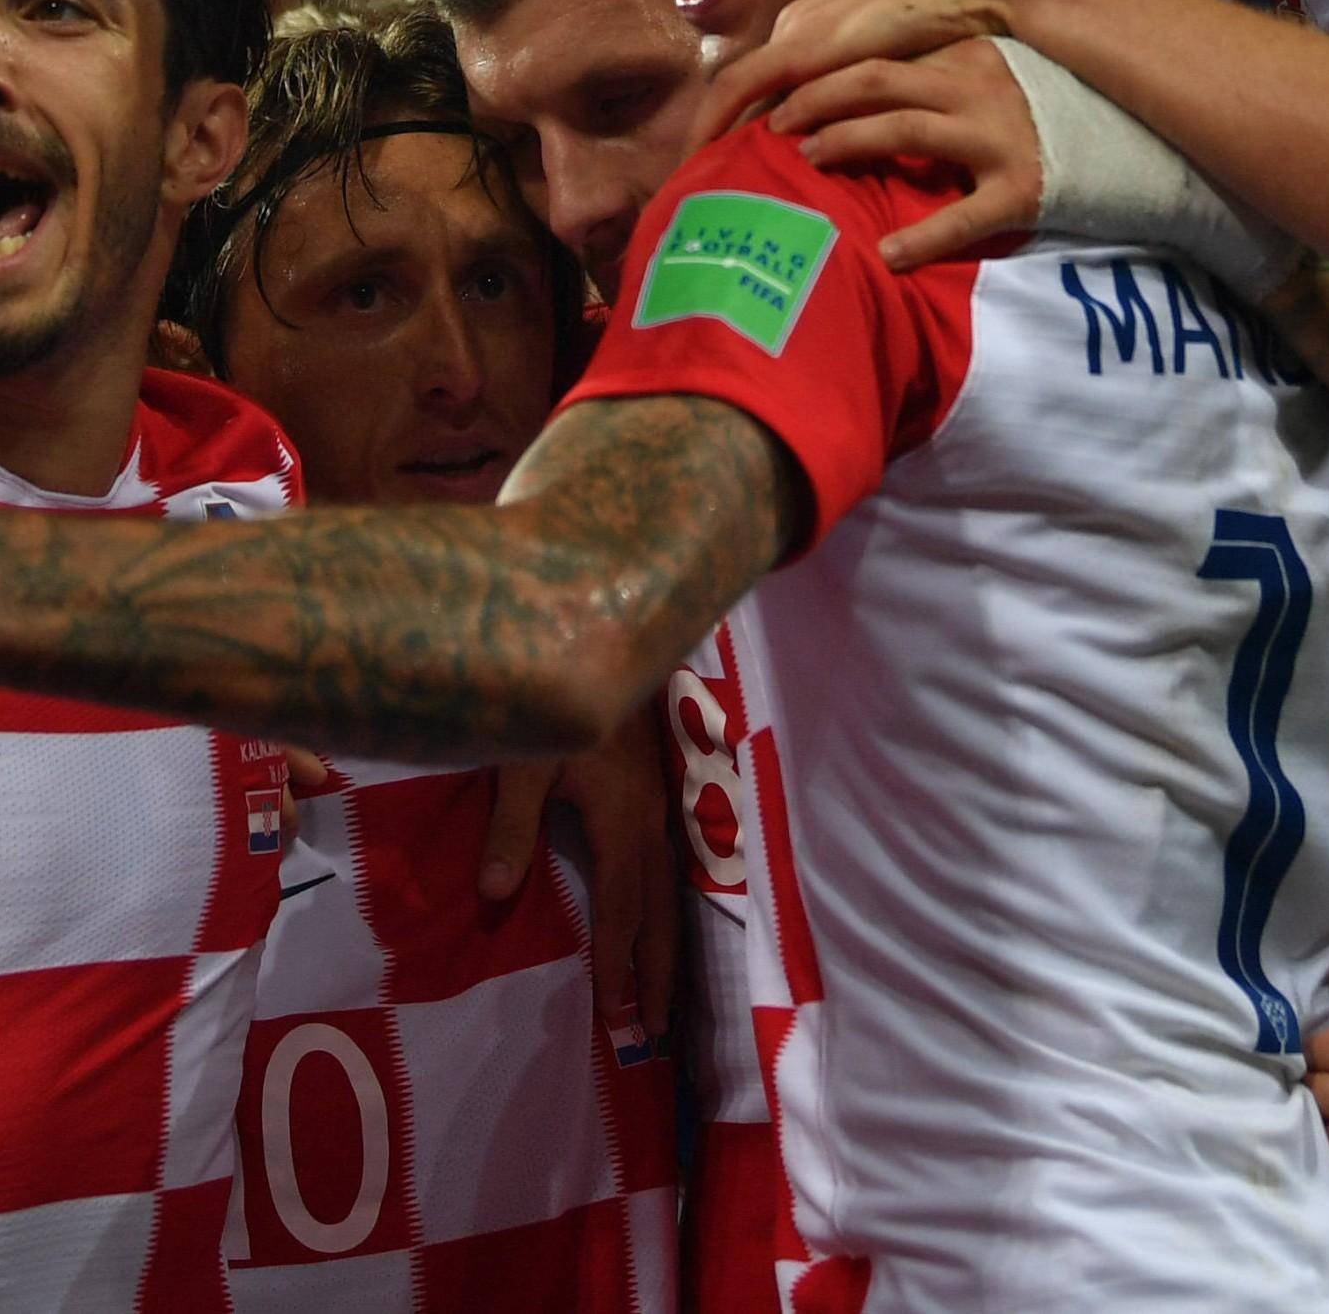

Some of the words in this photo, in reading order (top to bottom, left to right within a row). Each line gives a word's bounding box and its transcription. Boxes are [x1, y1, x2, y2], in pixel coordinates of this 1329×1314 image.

[673, 226, 806, 270] LIVING
[739, 274, 785, 312] FIFA
[668, 669, 747, 887] 8
